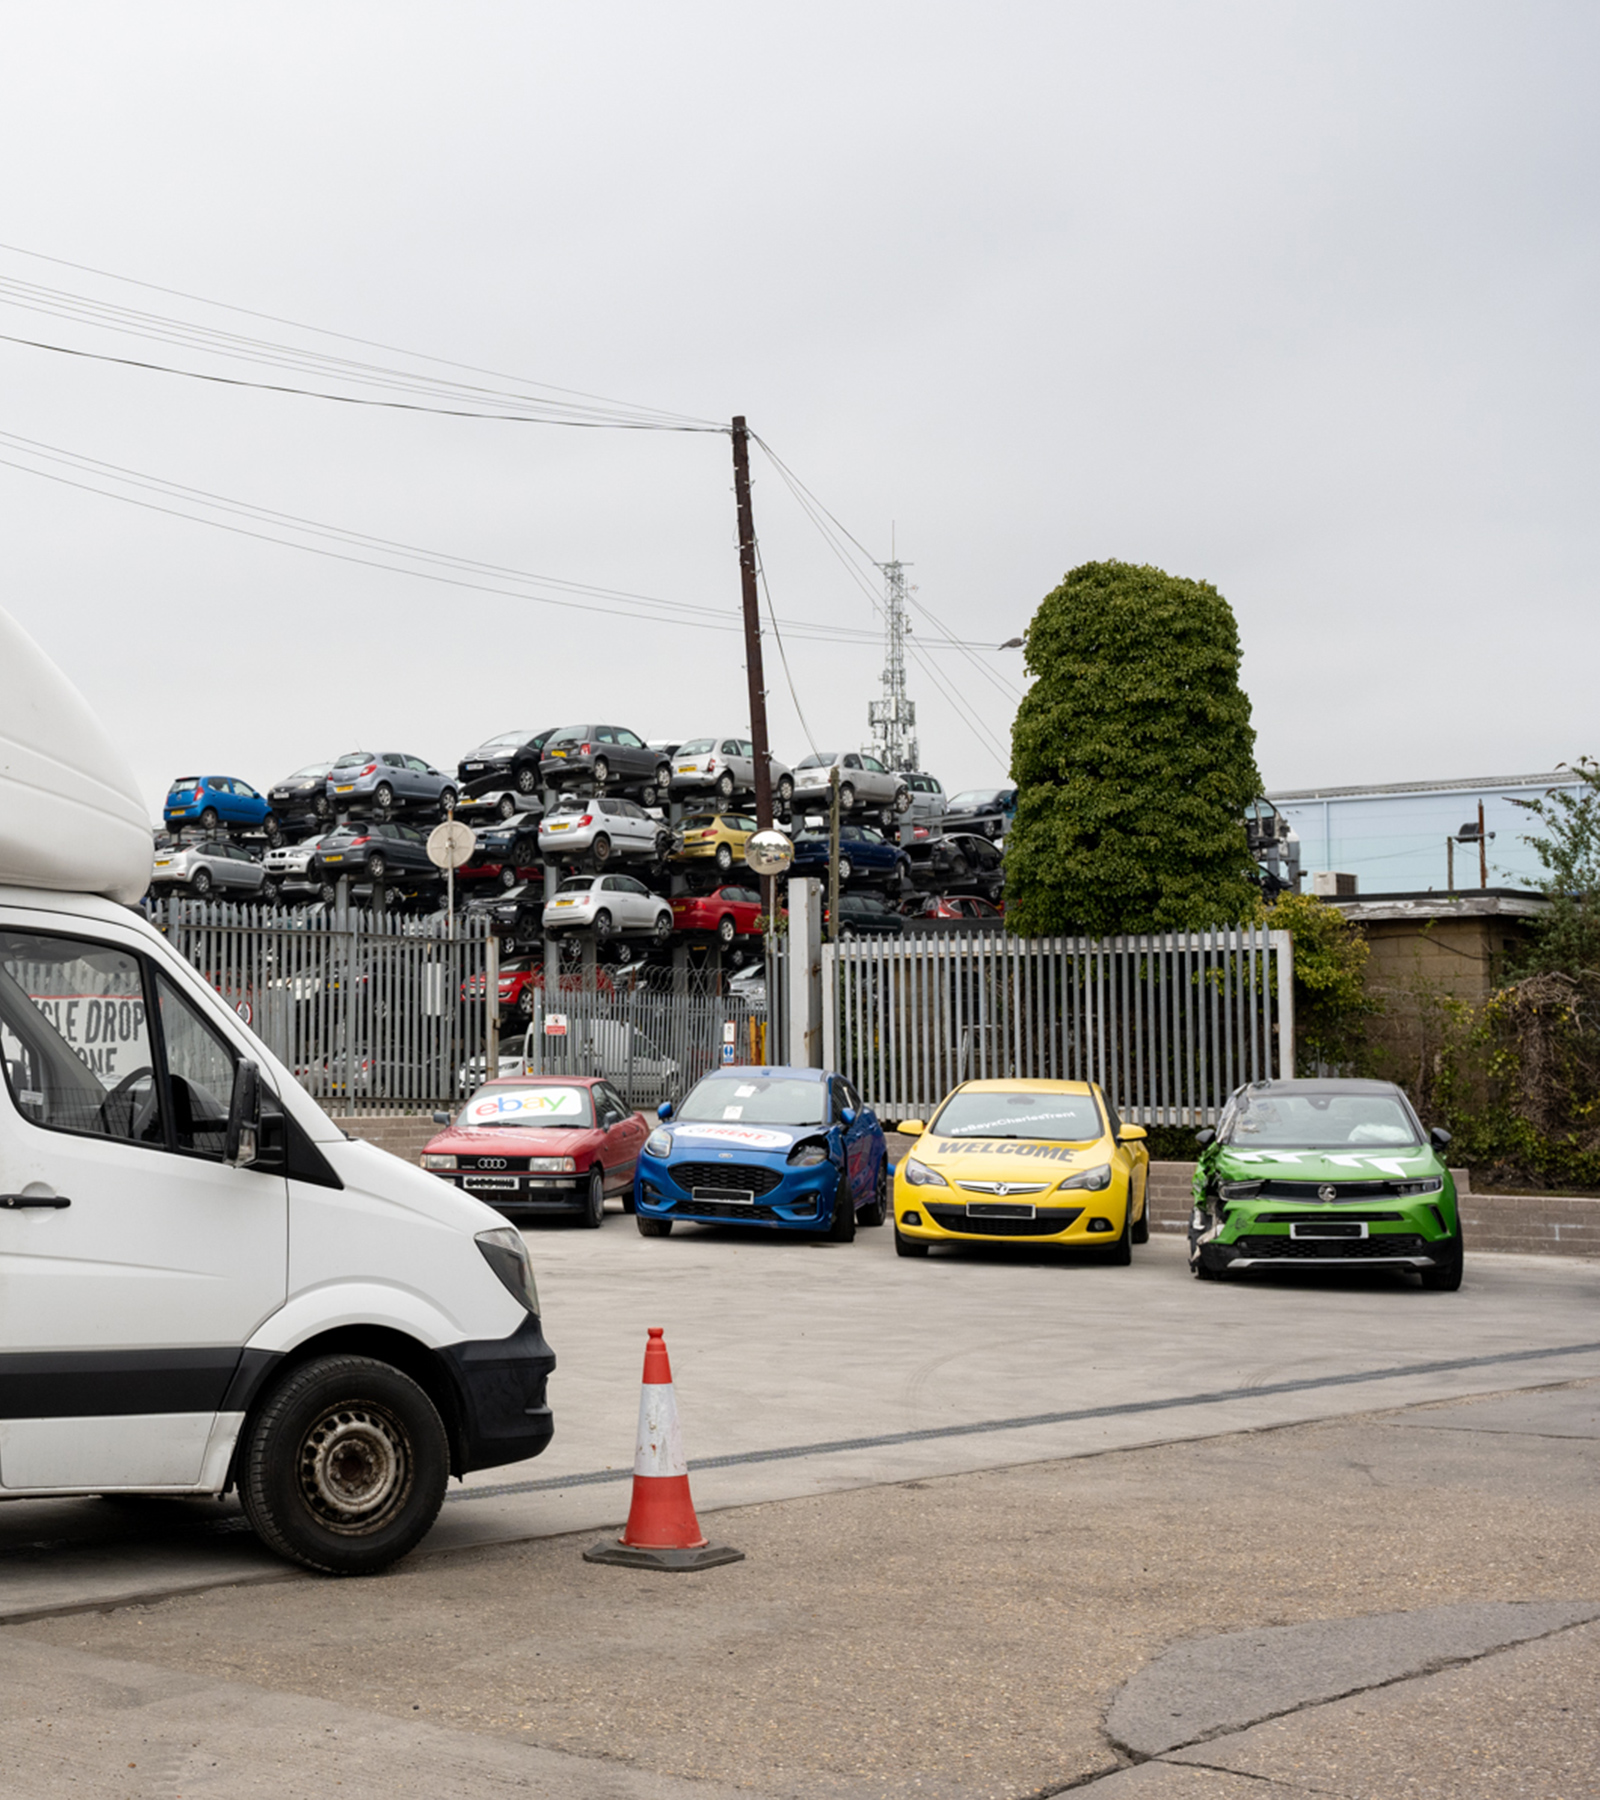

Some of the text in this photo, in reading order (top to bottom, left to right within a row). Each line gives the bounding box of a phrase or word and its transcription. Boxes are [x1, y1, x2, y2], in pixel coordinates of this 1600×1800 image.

[85, 1000, 144, 1043] DROP
[72, 1046, 117, 1073] ONE
[475, 1095, 567, 1116] ebay
[705, 1128, 768, 1140] TRENT
[937, 1142, 1079, 1162] WELCOME
